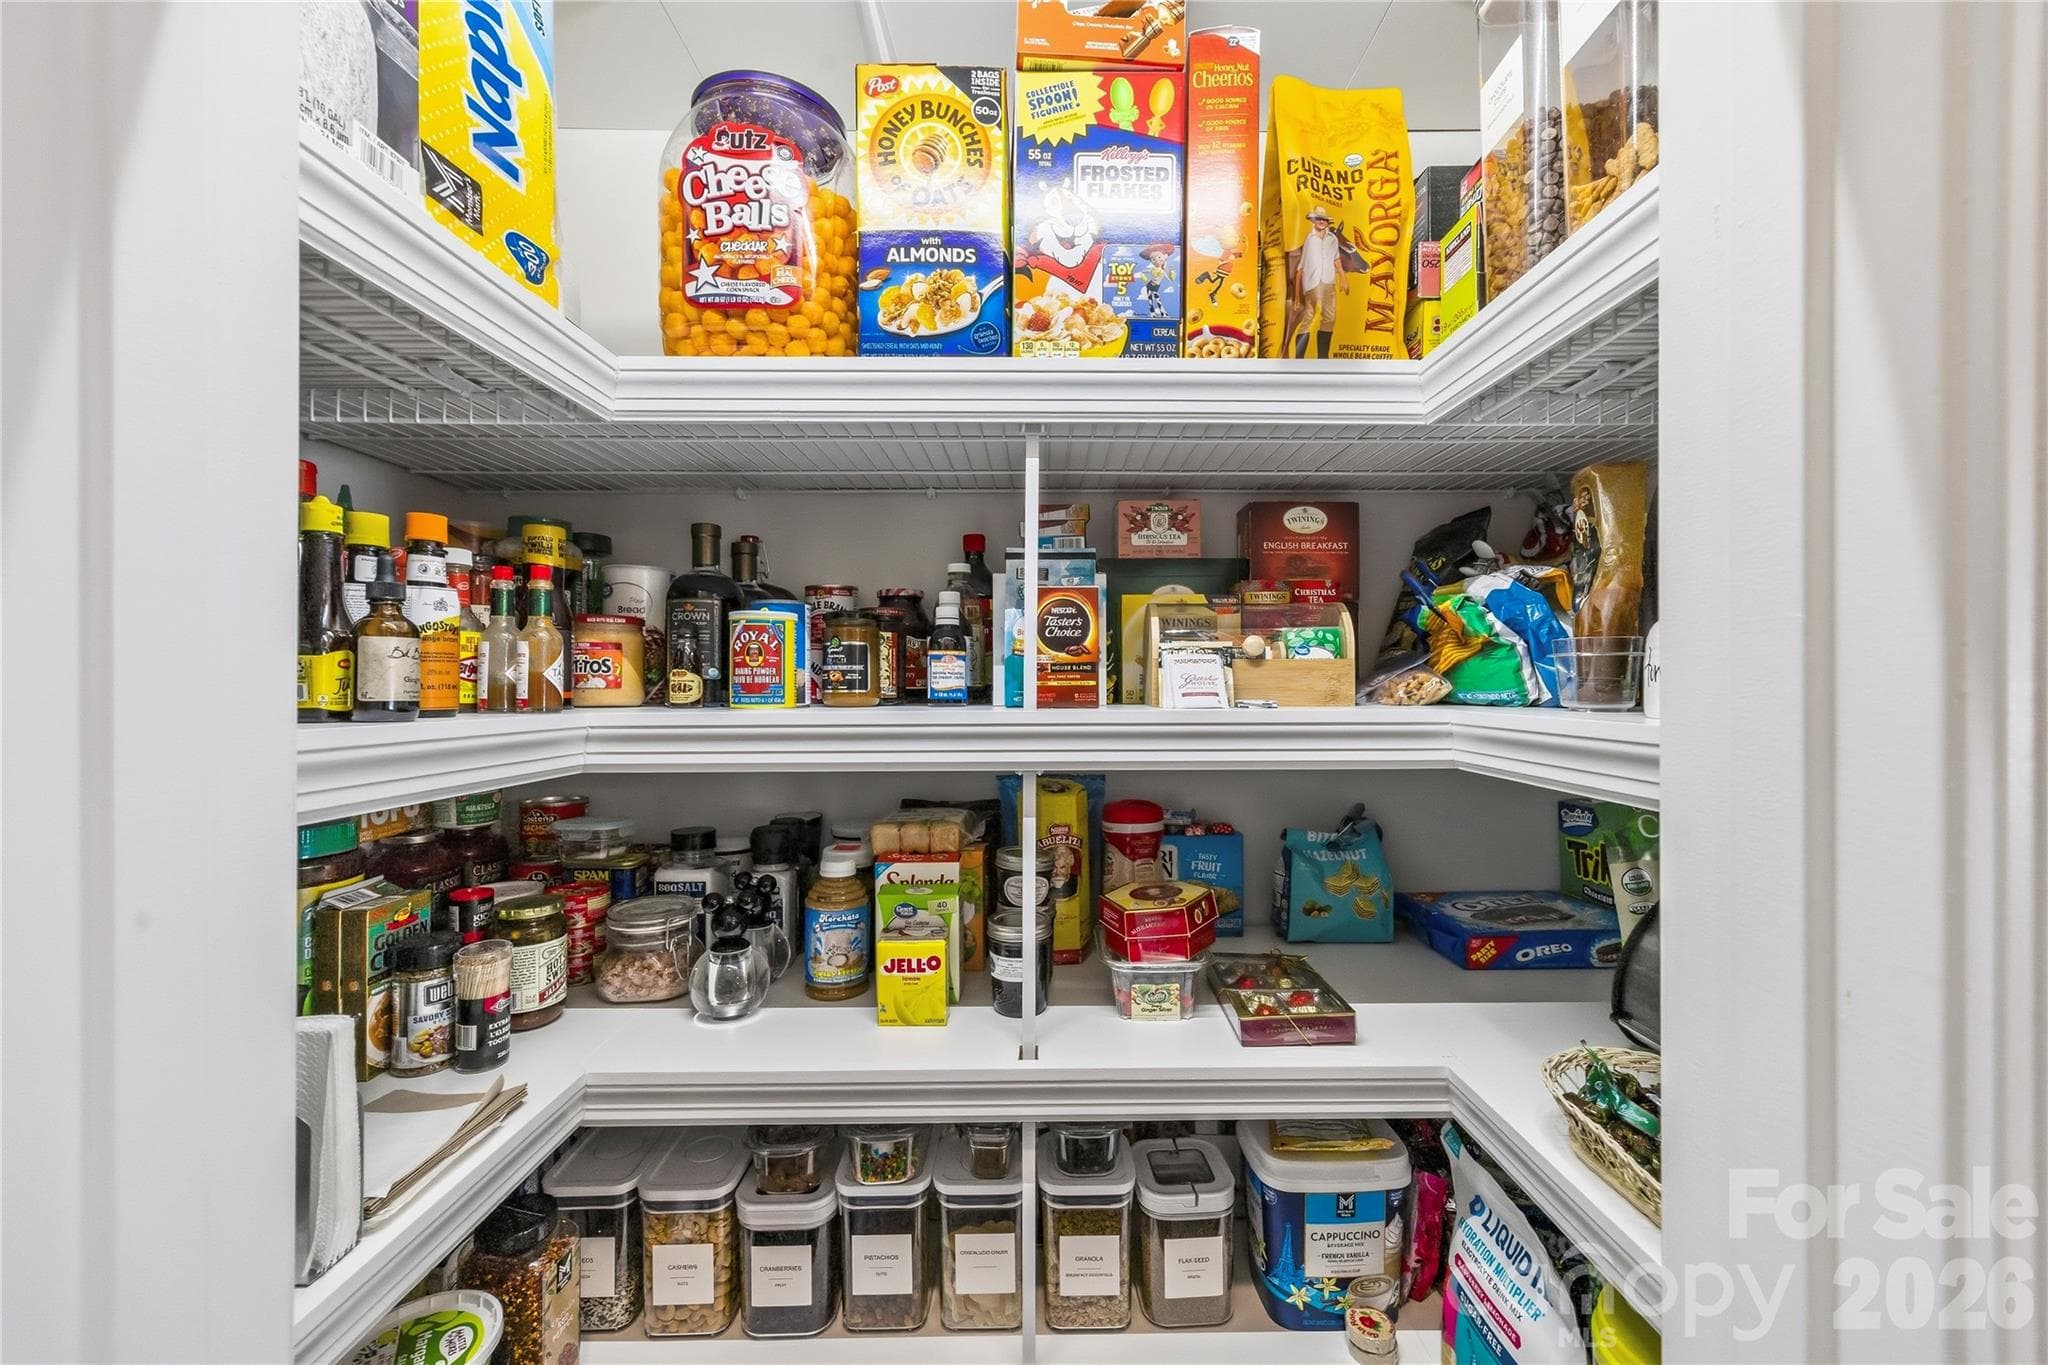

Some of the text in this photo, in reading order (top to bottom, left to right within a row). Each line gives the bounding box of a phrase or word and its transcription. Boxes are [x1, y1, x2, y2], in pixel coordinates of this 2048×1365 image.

[971, 70, 977, 78] 2
[1214, 64, 1236, 72] Honey
[971, 78, 1000, 87] INSIDE
[1193, 70, 1254, 88] Cheerios
[868, 77, 897, 96] Post
[1026, 80, 1075, 98] COLLECTIBLE
[1031, 102, 1075, 119] FIGURINE
[877, 100, 984, 169] HONEY BUNCHES
[1028, 149, 1041, 160] 55
[1101, 146, 1150, 164] Kellogg's
[1080, 165, 1170, 182] FROSTED
[1287, 157, 1364, 185] CUBANO
[682, 161, 802, 207] Cheese
[1297, 175, 1355, 201] ROAST
[1087, 183, 1162, 199] FLAKES
[701, 199, 790, 236] Balls
[921, 237, 941, 246] with
[1353, 149, 1401, 336] MAYORGA
[887, 248, 976, 264] ALMONDS
[1108, 262, 1136, 276] TOY
[1066, 275, 1083, 287] TONY
[1117, 282, 1127, 295] 5
[1153, 328, 1177, 337] CEREAL
[1130, 343, 1177, 352] NET WT 55 OZ
[1339, 344, 1390, 353] SPECIALTY GRADE
[1286, 515, 1326, 526] TWININGS
[1263, 542, 1348, 550] ENGLISH BREAKFAST
[1248, 593, 1287, 601] TWININGS
[1294, 587, 1336, 596] CHRISTMAS
[1308, 596, 1324, 604] TEA
[618, 605, 645, 614] Bread
[672, 612, 710, 621] CROWN
[1043, 614, 1083, 627] Taster's
[1160, 615, 1210, 627] WININGS
[418, 621, 459, 635] NGOSTUR
[1045, 627, 1082, 637] Choice
[733, 631, 780, 652] ROYAL
[753, 667, 777, 675] POWDER
[472, 862, 497, 877] CLAS
[1191, 861, 1222, 872] FRUIT
[573, 870, 609, 880] SPAM
[886, 871, 954, 885] Splenda
[1194, 872, 1217, 880] FLAVOR
[896, 905, 914, 913] Great
[936, 901, 948, 909] 40
[374, 919, 429, 951] GOLDEN
[1470, 940, 1496, 962] PARTY
[1480, 948, 1498, 964] SIZE
[1515, 943, 1573, 962] OREO
[412, 1011, 444, 1024] SAVORY
[1311, 1230, 1381, 1241] CAPPUCCINO
[1481, 1207, 1533, 1277] LIQUID
[759, 1265, 802, 1273] CRANBERRIES
[1458, 1216, 1544, 1322] HYDRATION MULTIPLIER
[1461, 1240, 1524, 1322] ELECTROLYTE DRINK MIX
